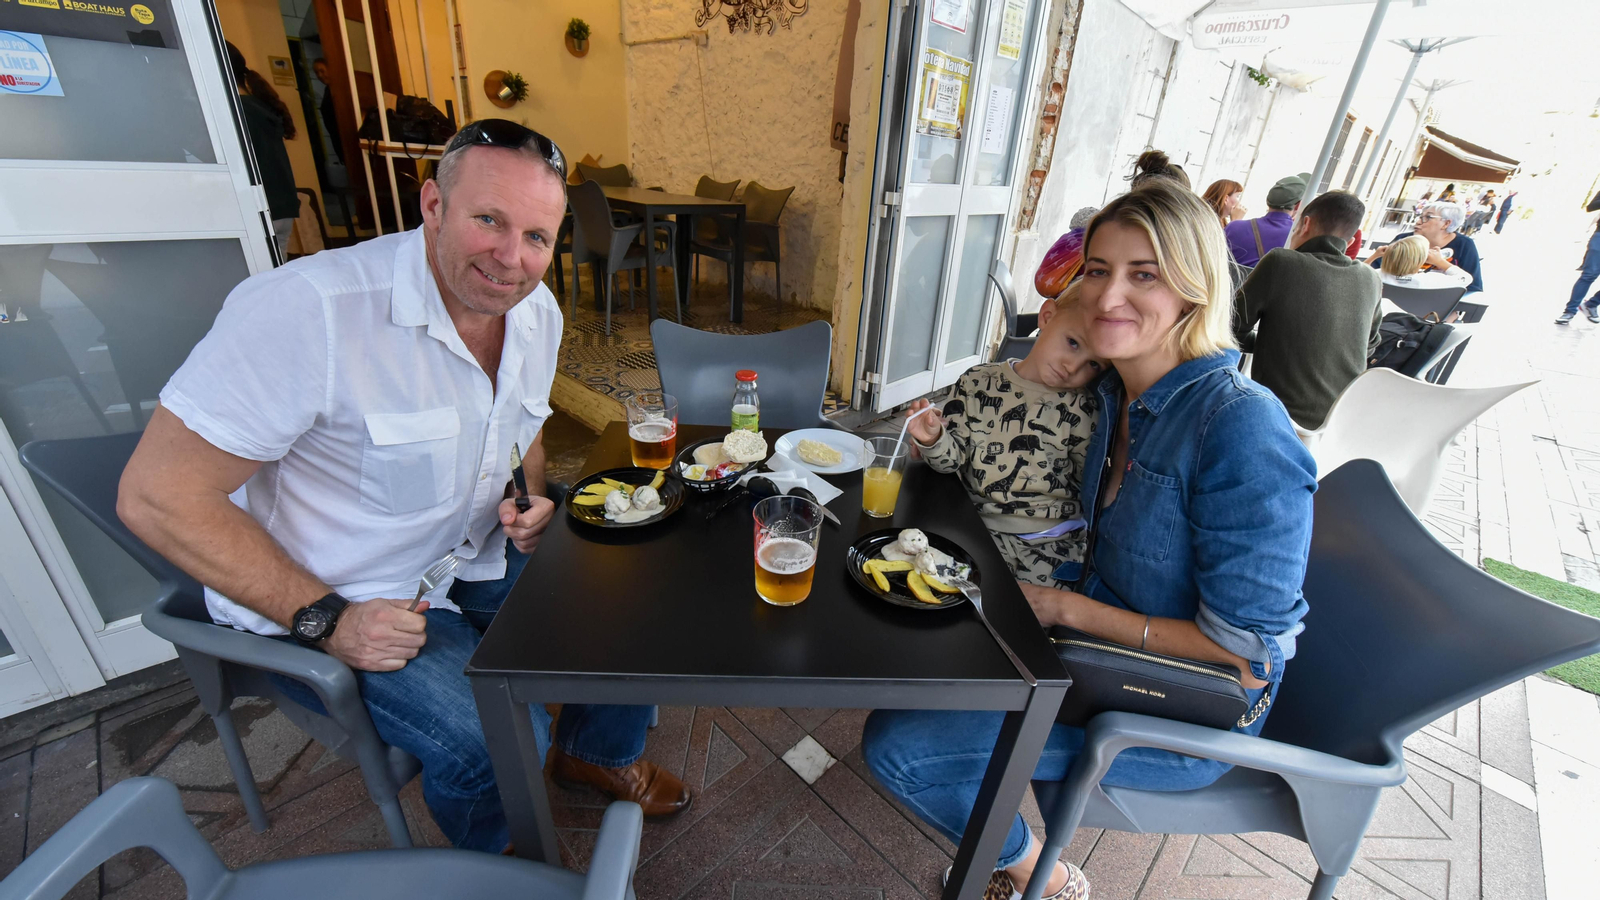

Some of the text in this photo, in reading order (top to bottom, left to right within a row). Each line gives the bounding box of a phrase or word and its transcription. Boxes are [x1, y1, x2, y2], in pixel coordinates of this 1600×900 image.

[73, 2, 98, 11] BOAT
[99, 5, 125, 15] HAUS
[0, 74, 16, 86] NO
[1123, 684, 1166, 699] MICHAEL KORS
